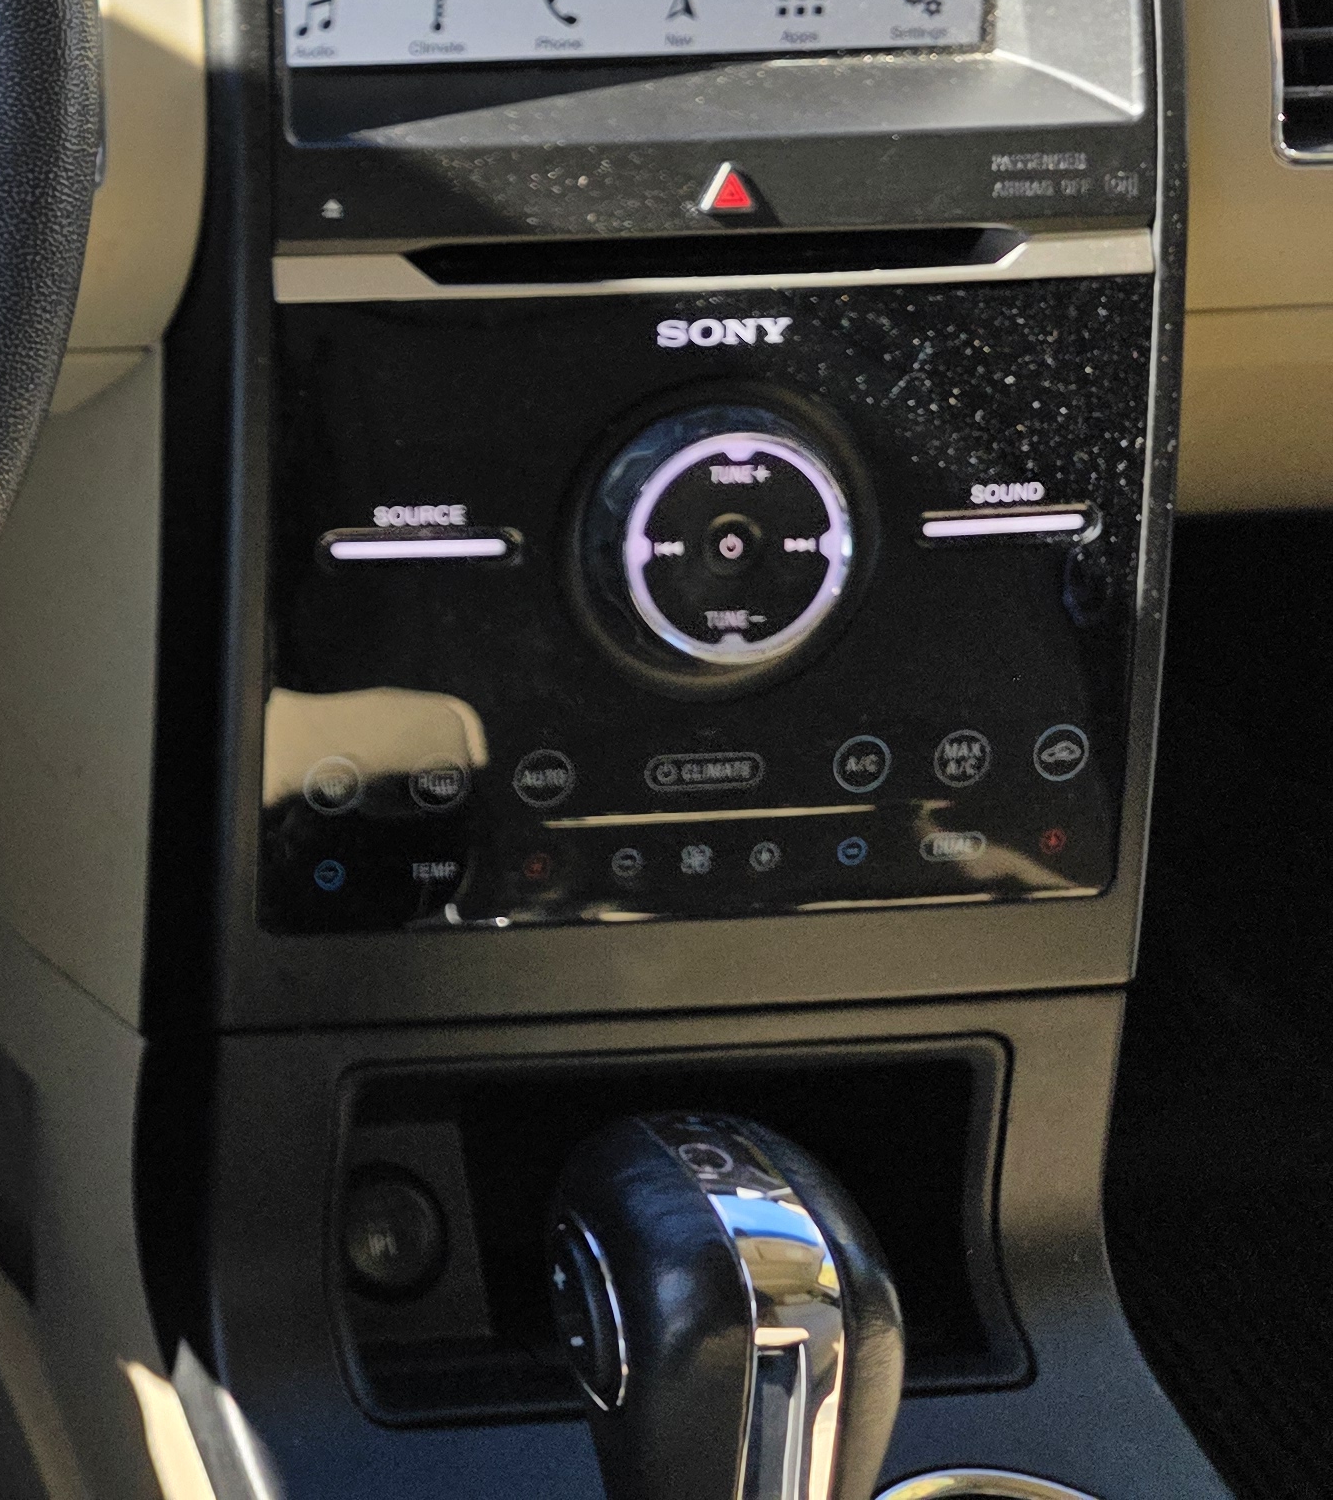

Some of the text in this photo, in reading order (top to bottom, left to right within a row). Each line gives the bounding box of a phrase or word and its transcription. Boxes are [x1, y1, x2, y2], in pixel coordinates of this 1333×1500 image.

[779, 29, 820, 45] Apps
[889, 24, 949, 41] Settings
[408, 39, 468, 57] Climate
[535, 34, 584, 51] Phone
[656, 316, 794, 348] SONY
[970, 481, 1046, 504] SOUND
[373, 504, 468, 527] SOURCE
[943, 741, 983, 759] MAX
[681, 760, 753, 782] CLIMATE
[844, 753, 879, 774] A/C
[946, 758, 979, 776] A/C
[412, 861, 459, 882] TEMP
